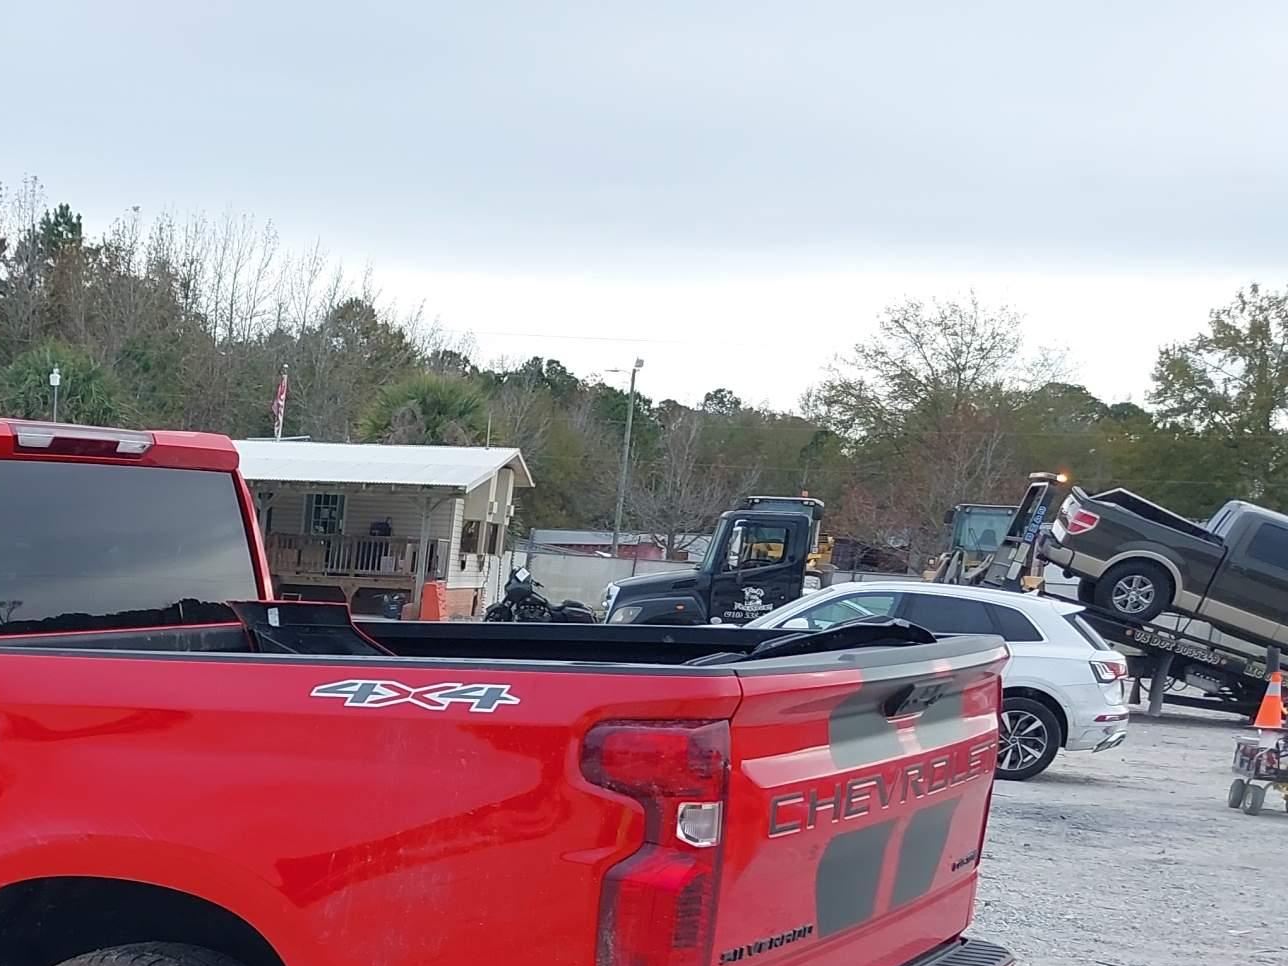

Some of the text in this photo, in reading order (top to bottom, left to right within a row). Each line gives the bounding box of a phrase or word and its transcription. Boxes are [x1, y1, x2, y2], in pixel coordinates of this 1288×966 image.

[1134, 630, 1150, 644] US
[1150, 634, 1176, 651] DOT
[768, 738, 998, 838] CHEVROLET
